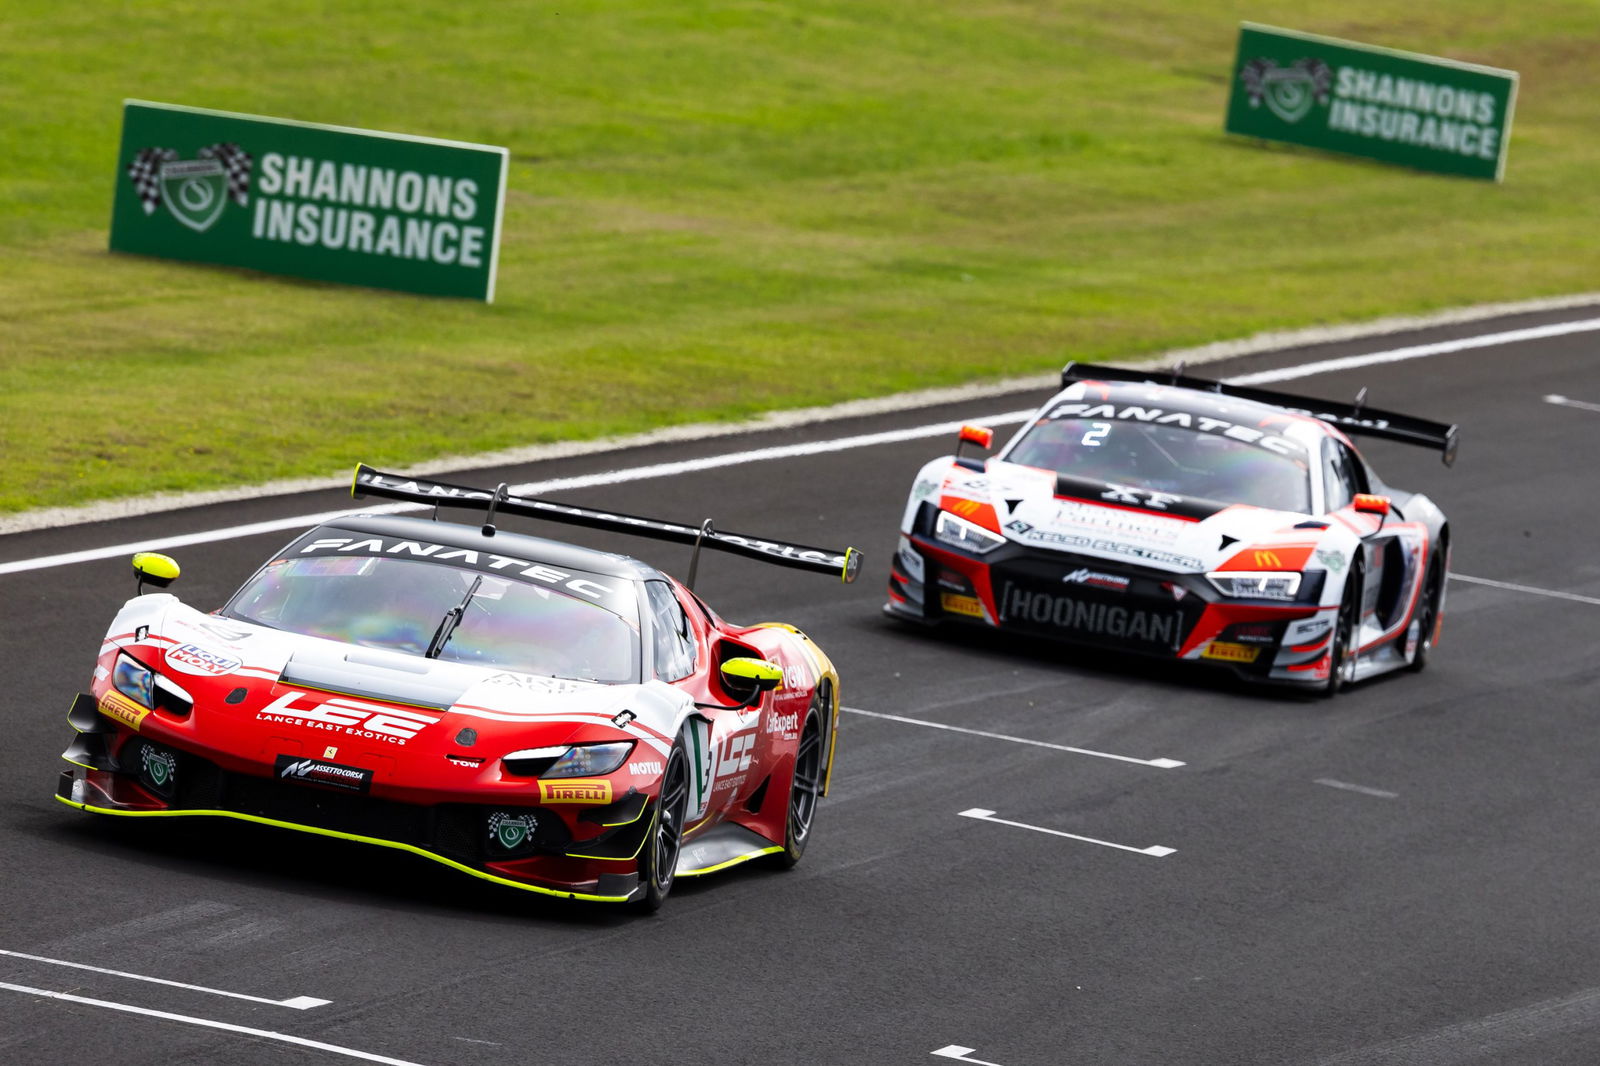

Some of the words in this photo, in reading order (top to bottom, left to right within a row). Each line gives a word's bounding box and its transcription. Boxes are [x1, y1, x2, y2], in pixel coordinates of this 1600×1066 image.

[1333, 66, 1496, 125] SHANNONS
[1326, 100, 1498, 159] INSURANCE
[258, 152, 479, 221] SHANNONS
[252, 199, 485, 268] INSURANCE
[1049, 403, 1299, 454] FANATEC
[1081, 422, 1112, 447] 2
[300, 539, 614, 599] FANATEC
[167, 649, 227, 674] MOLY
[180, 644, 240, 669] LIQUI
[101, 695, 142, 724] PIRELLI
[259, 691, 441, 739] LEE
[256, 713, 303, 726] LANCE
[306, 720, 342, 732] EAST
[345, 727, 407, 746] EXOTICS
[449, 758, 480, 769] TOW
[629, 761, 663, 775] MOTUL
[544, 784, 606, 800] PIRELLI
